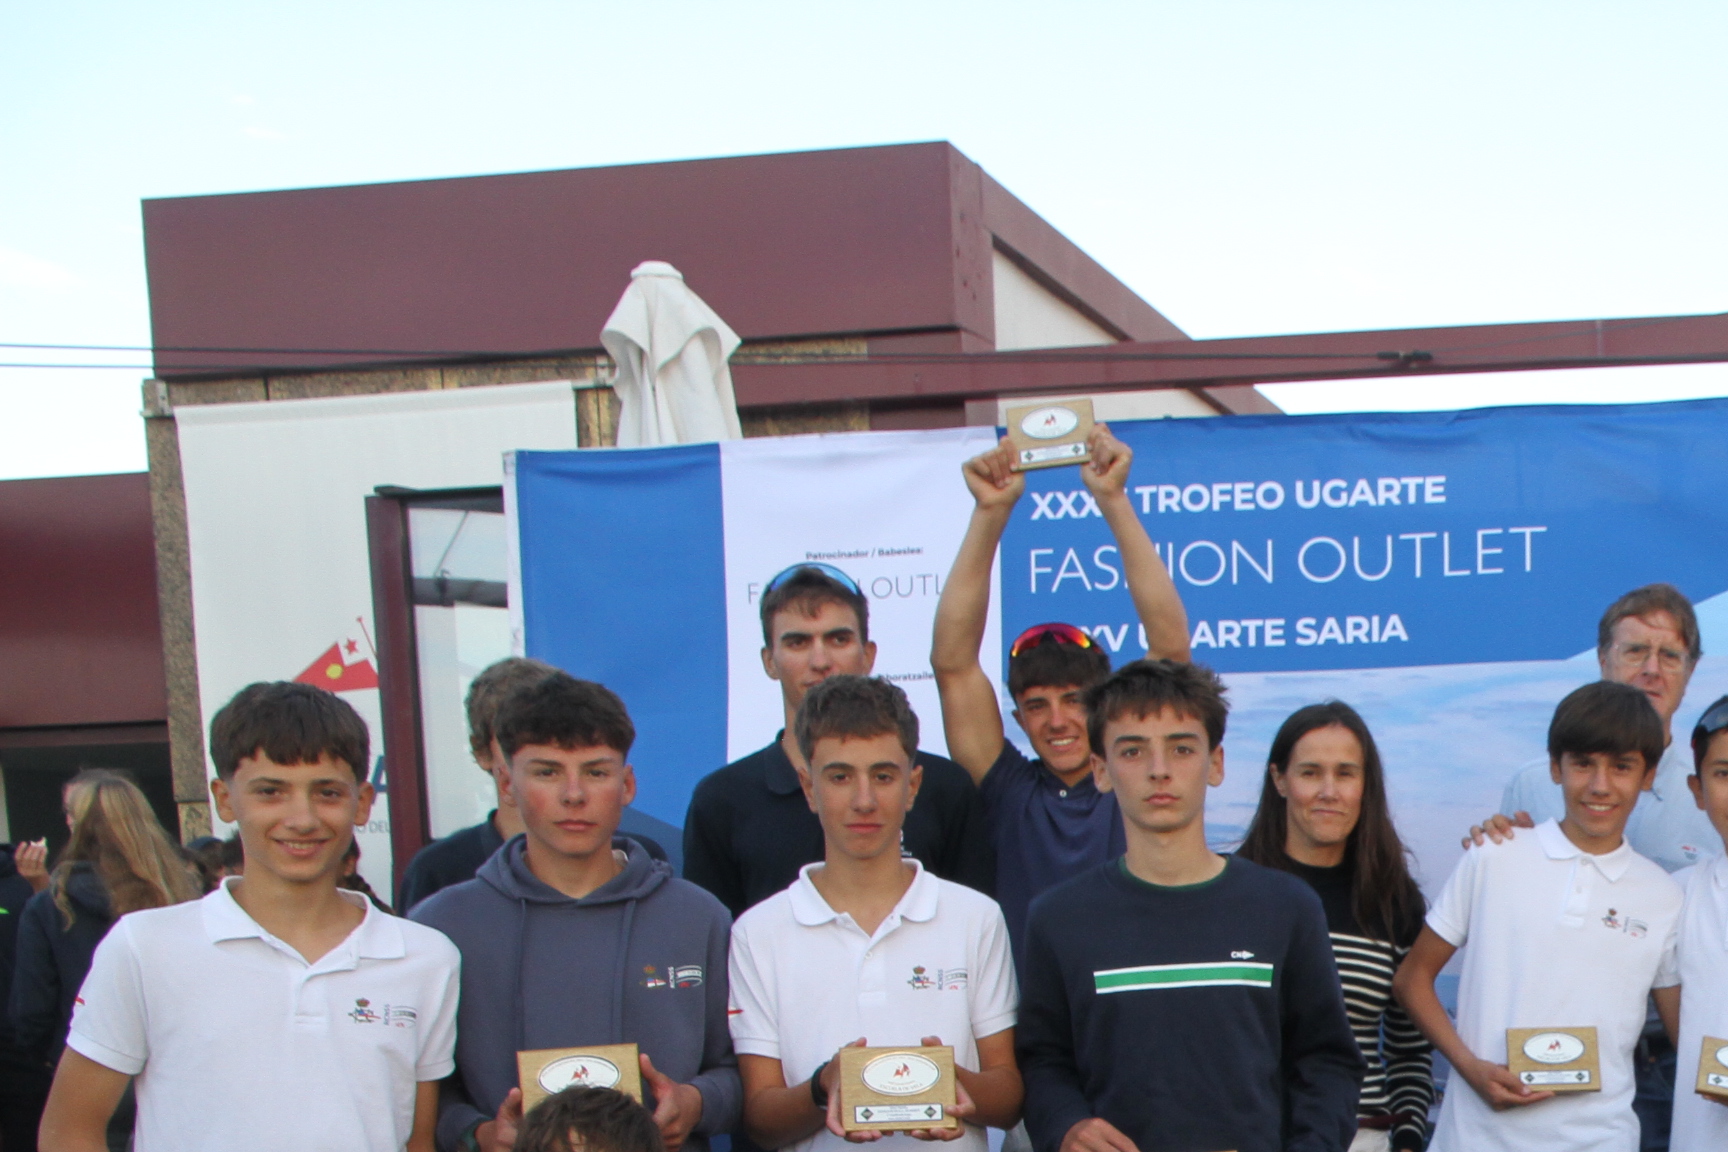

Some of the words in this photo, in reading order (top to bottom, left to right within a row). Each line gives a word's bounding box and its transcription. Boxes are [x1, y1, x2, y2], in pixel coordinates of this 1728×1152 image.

[1030, 488, 1127, 521] XXX
[1134, 481, 1285, 514] TROFEO
[1295, 475, 1447, 510] UGARTE
[805, 549, 869, 560] Patrocinador
[877, 546, 924, 557] Babeslea:
[1030, 540, 1274, 594] FASION
[1298, 525, 1548, 584] OUTLET
[871, 573, 942, 600] OUTL
[1295, 614, 1409, 646] SARIA
